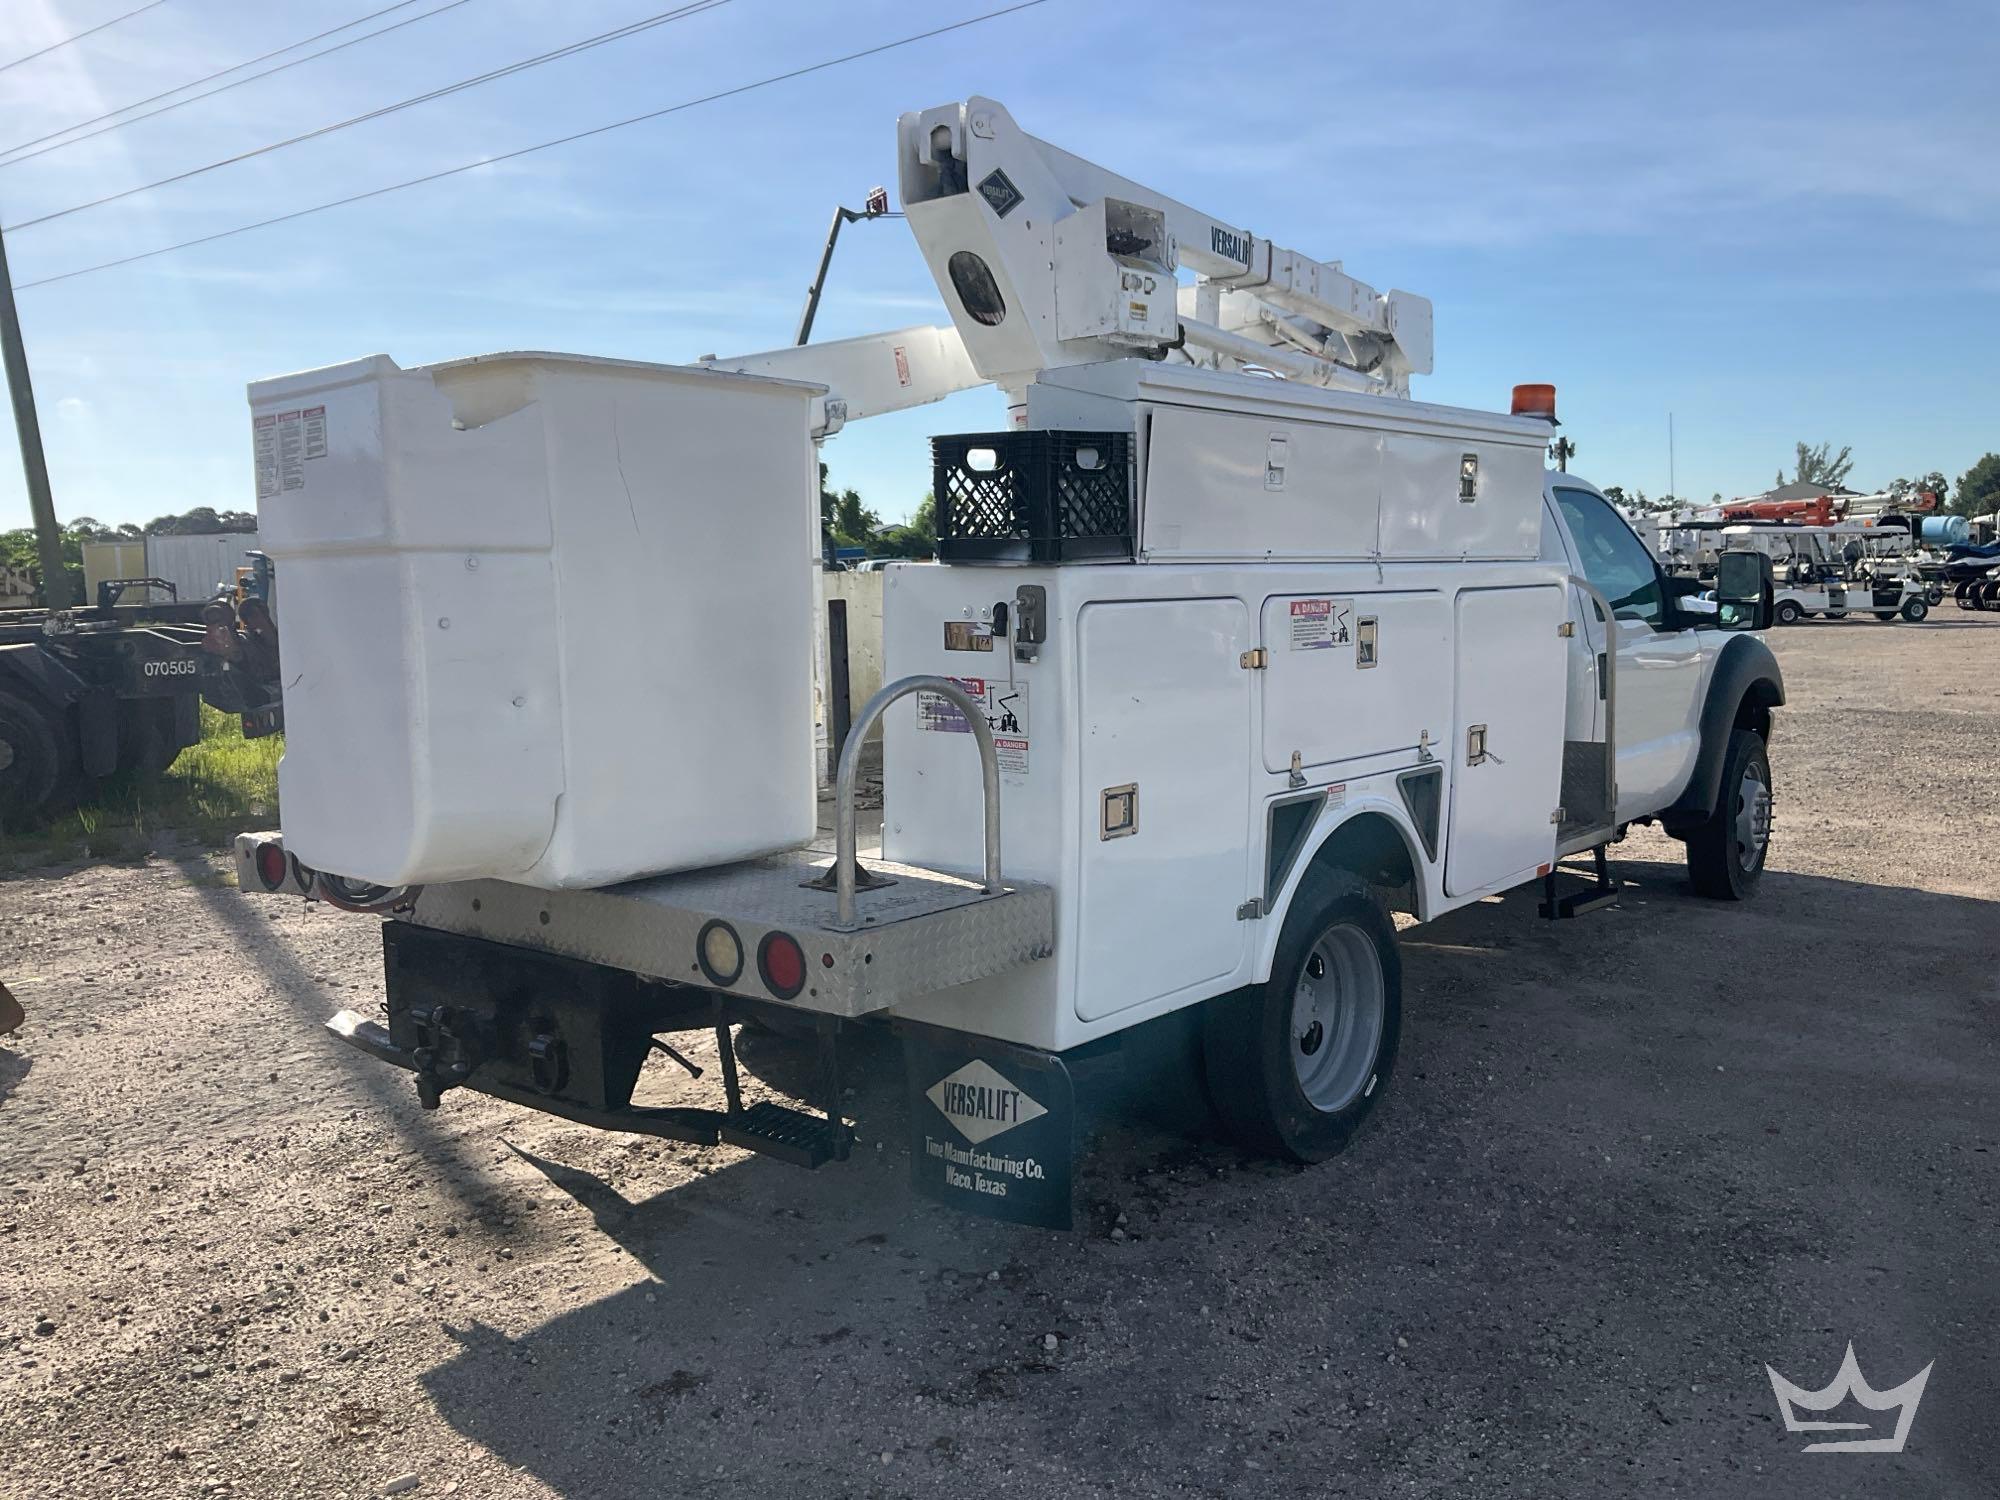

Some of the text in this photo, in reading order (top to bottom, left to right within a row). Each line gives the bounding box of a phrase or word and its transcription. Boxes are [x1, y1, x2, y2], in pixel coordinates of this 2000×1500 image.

[144, 660, 196, 676] 070505
[1002, 740, 1026, 749] DANGER
[943, 1081, 1020, 1122] VERSALIFT
[944, 1141, 1024, 1179] Manufacturing
[1025, 1158, 1045, 1180] Co.
[974, 1172, 1007, 1197] Texas
